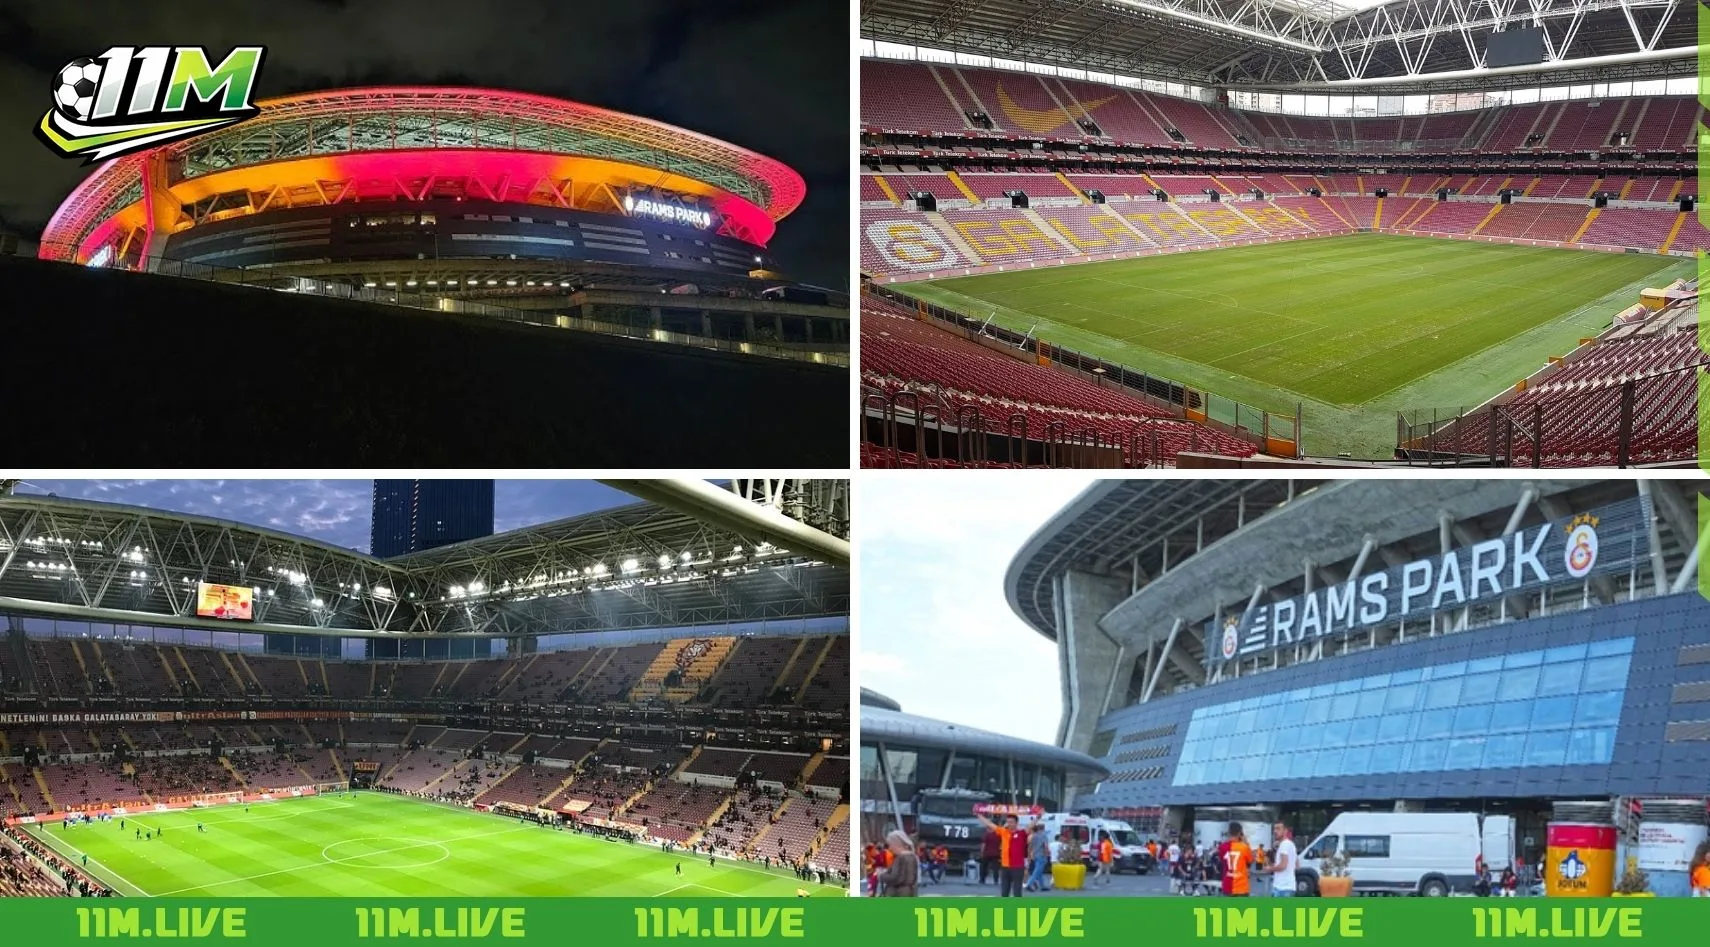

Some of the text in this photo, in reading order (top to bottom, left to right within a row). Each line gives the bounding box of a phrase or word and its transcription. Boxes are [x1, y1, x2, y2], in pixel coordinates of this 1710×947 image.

[676, 207, 704, 224] PARK
[1273, 523, 1552, 646] RAMS PARK
[84, 713, 139, 721] GALATASARAY
[943, 824, 970, 838] T 78
[1223, 851, 1241, 871] 17
